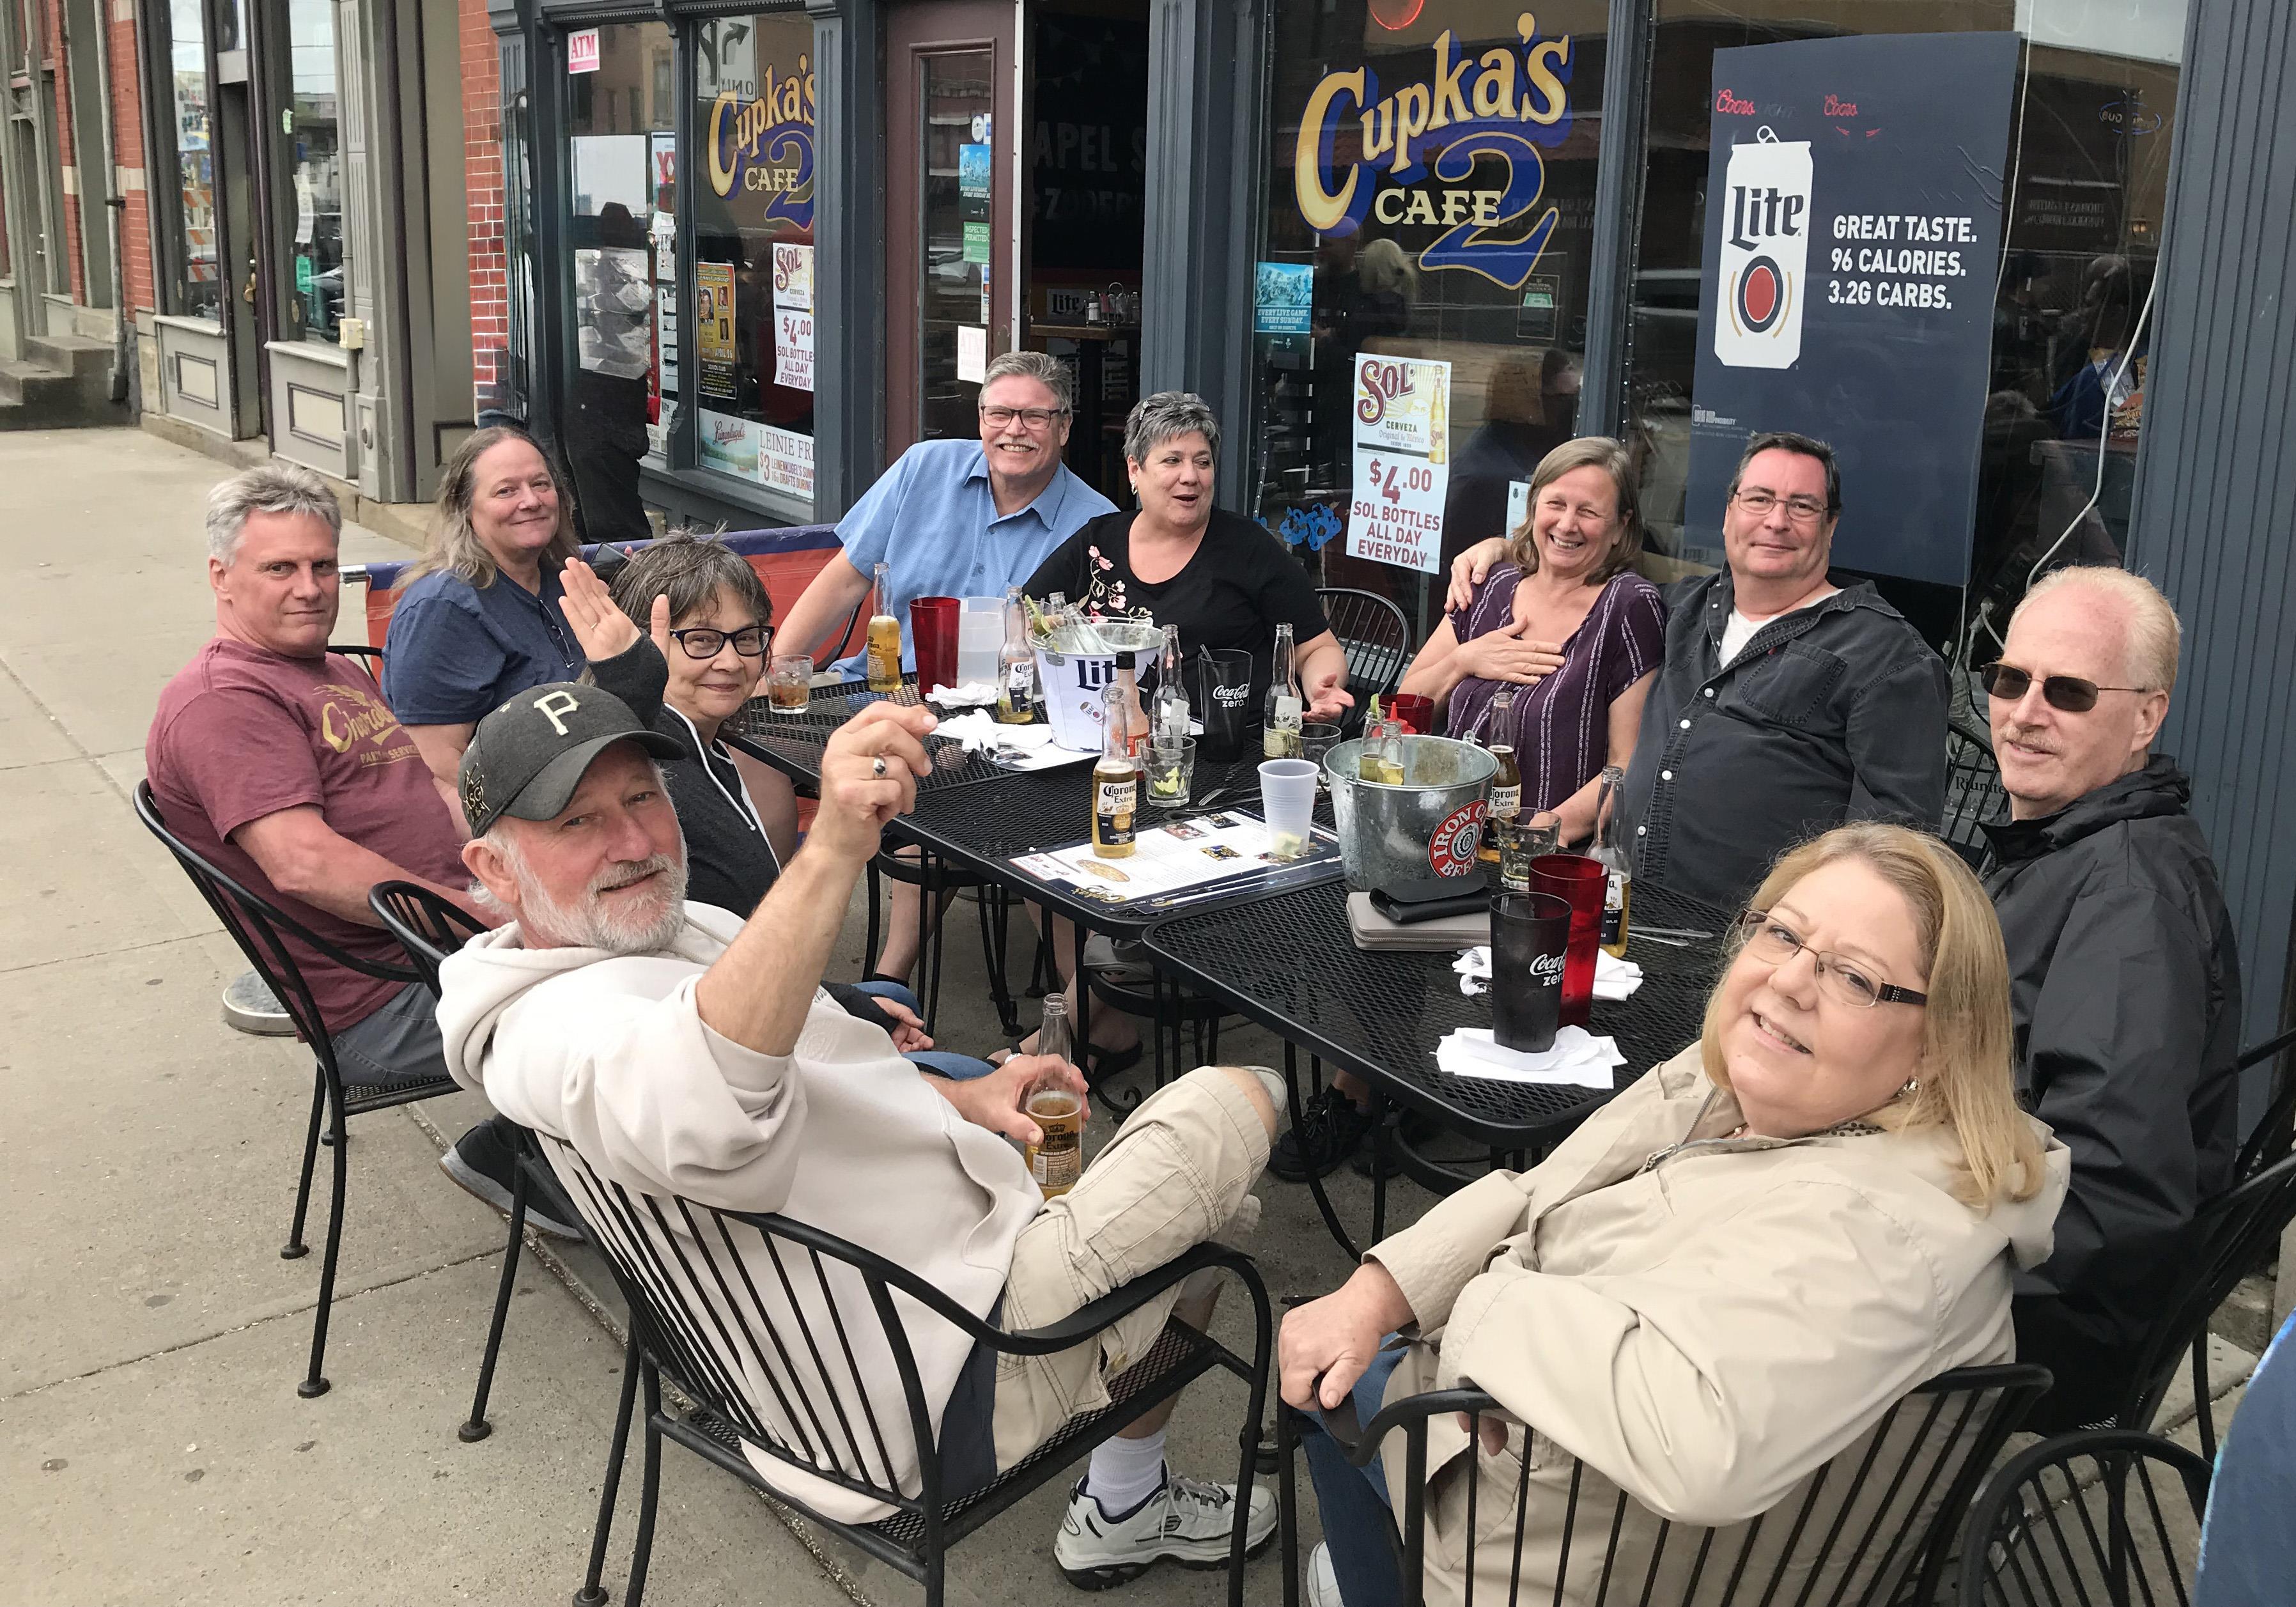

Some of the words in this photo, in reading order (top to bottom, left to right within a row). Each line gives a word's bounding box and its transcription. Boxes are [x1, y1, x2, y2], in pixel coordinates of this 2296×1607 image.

[570, 34, 596, 59] ATM
[1716, 89, 1755, 116] Coors
[1295, 13, 1569, 229] Cupka's
[745, 167, 798, 192] CAFE
[1375, 188, 1501, 227] CAFE
[1418, 132, 1559, 290] 2
[1728, 186, 1804, 251] Lite
[965, 225, 988, 233] INSPECTED
[965, 234, 987, 242] PERMITTED
[1833, 215, 1900, 240] GREAT
[1905, 216, 1977, 242] TASTE.
[775, 247, 802, 293] SOL
[1831, 247, 1853, 272] 96
[1858, 249, 1966, 276] CALORIES.
[1828, 280, 1872, 305] 3.2G
[1877, 282, 1951, 309] CARBS.
[783, 315, 811, 346] $4.00
[777, 346, 789, 358] SOL
[780, 372, 812, 389] EVERYDAY
[784, 360, 794, 371] ALL
[795, 362, 809, 374] DAY
[1357, 360, 1415, 426] SOL
[1386, 421, 1418, 433] CERVEZA
[759, 430, 795, 456] LEINIE
[759, 450, 770, 481] $3
[1369, 458, 1432, 504] $4.00
[1353, 501, 1377, 520] SOL
[1382, 506, 1440, 531] BOTTLES
[1367, 522, 1392, 541] ALL
[1395, 527, 1422, 547] DAY
[1358, 539, 1427, 568] EVERYDAY
[1074, 659, 1117, 691] Lit
[534, 690, 580, 736] P
[1222, 699, 1245, 708] zero
[1114, 795, 1133, 804] Extra
[1434, 806, 1471, 860] IRON
[1043, 1130, 1074, 1144] orona
